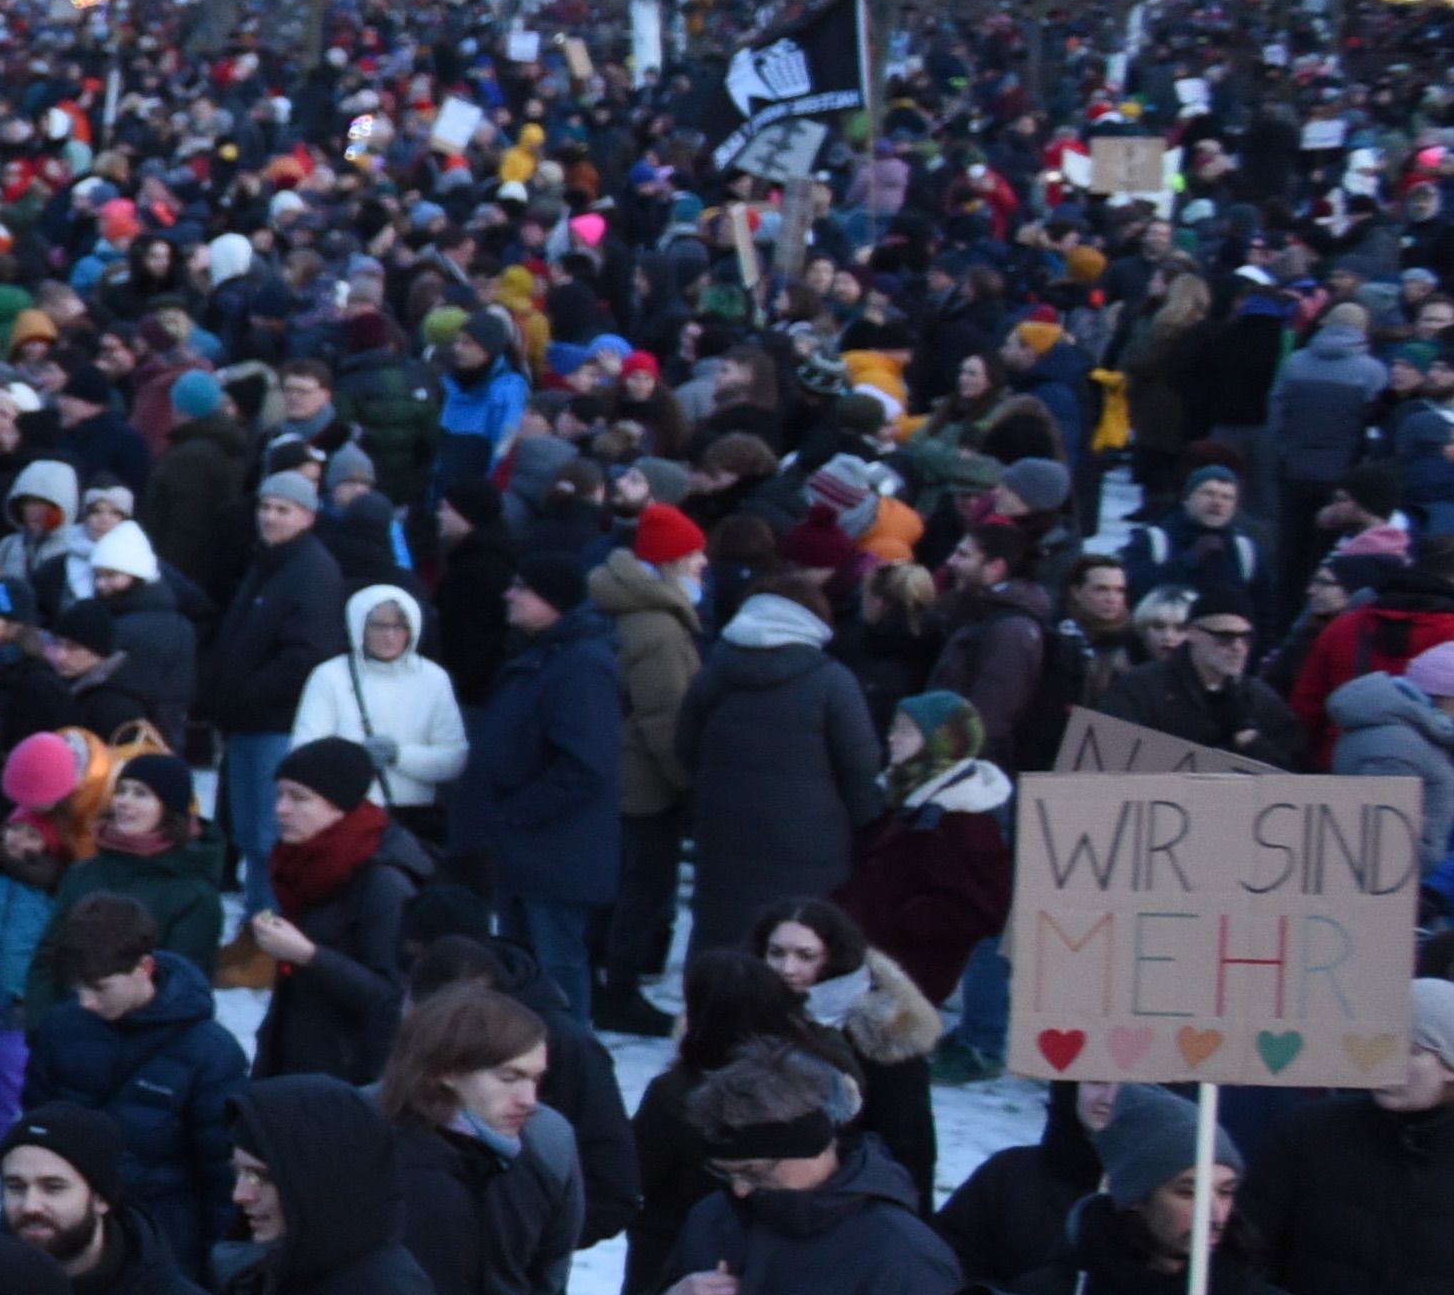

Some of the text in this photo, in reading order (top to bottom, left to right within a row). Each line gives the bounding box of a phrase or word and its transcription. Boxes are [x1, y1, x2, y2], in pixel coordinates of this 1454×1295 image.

[1037, 798, 1416, 895] WIR SIND
[1036, 910, 1355, 1017] MEHR
